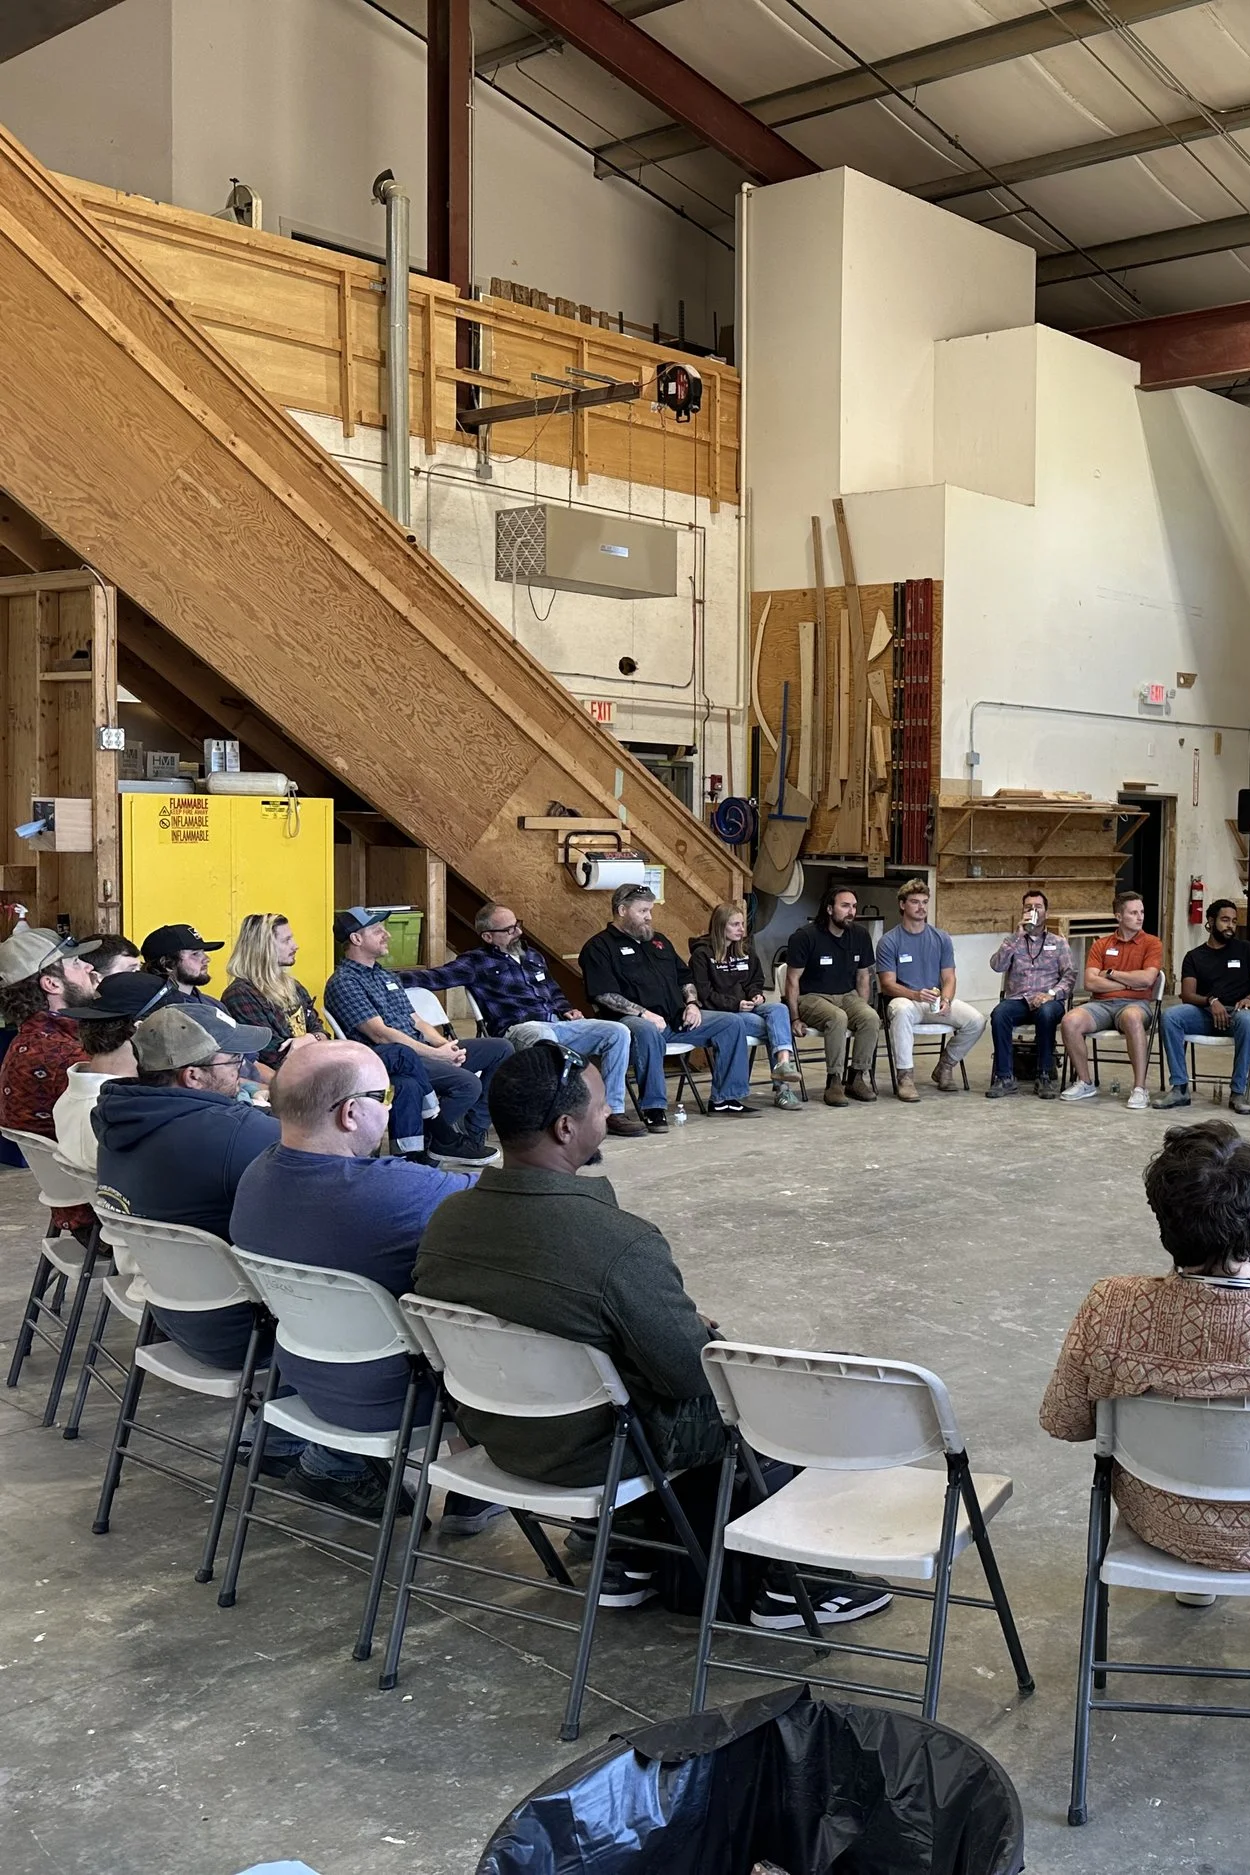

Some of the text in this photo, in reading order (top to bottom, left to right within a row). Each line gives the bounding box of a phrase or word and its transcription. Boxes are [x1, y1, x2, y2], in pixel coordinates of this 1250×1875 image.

[590, 700, 613, 721] EXIT
[169, 797, 209, 810] FLAMMABLE
[171, 815, 209, 828] INFLAMABLE
[171, 829, 210, 842] INFLAMMABLE
